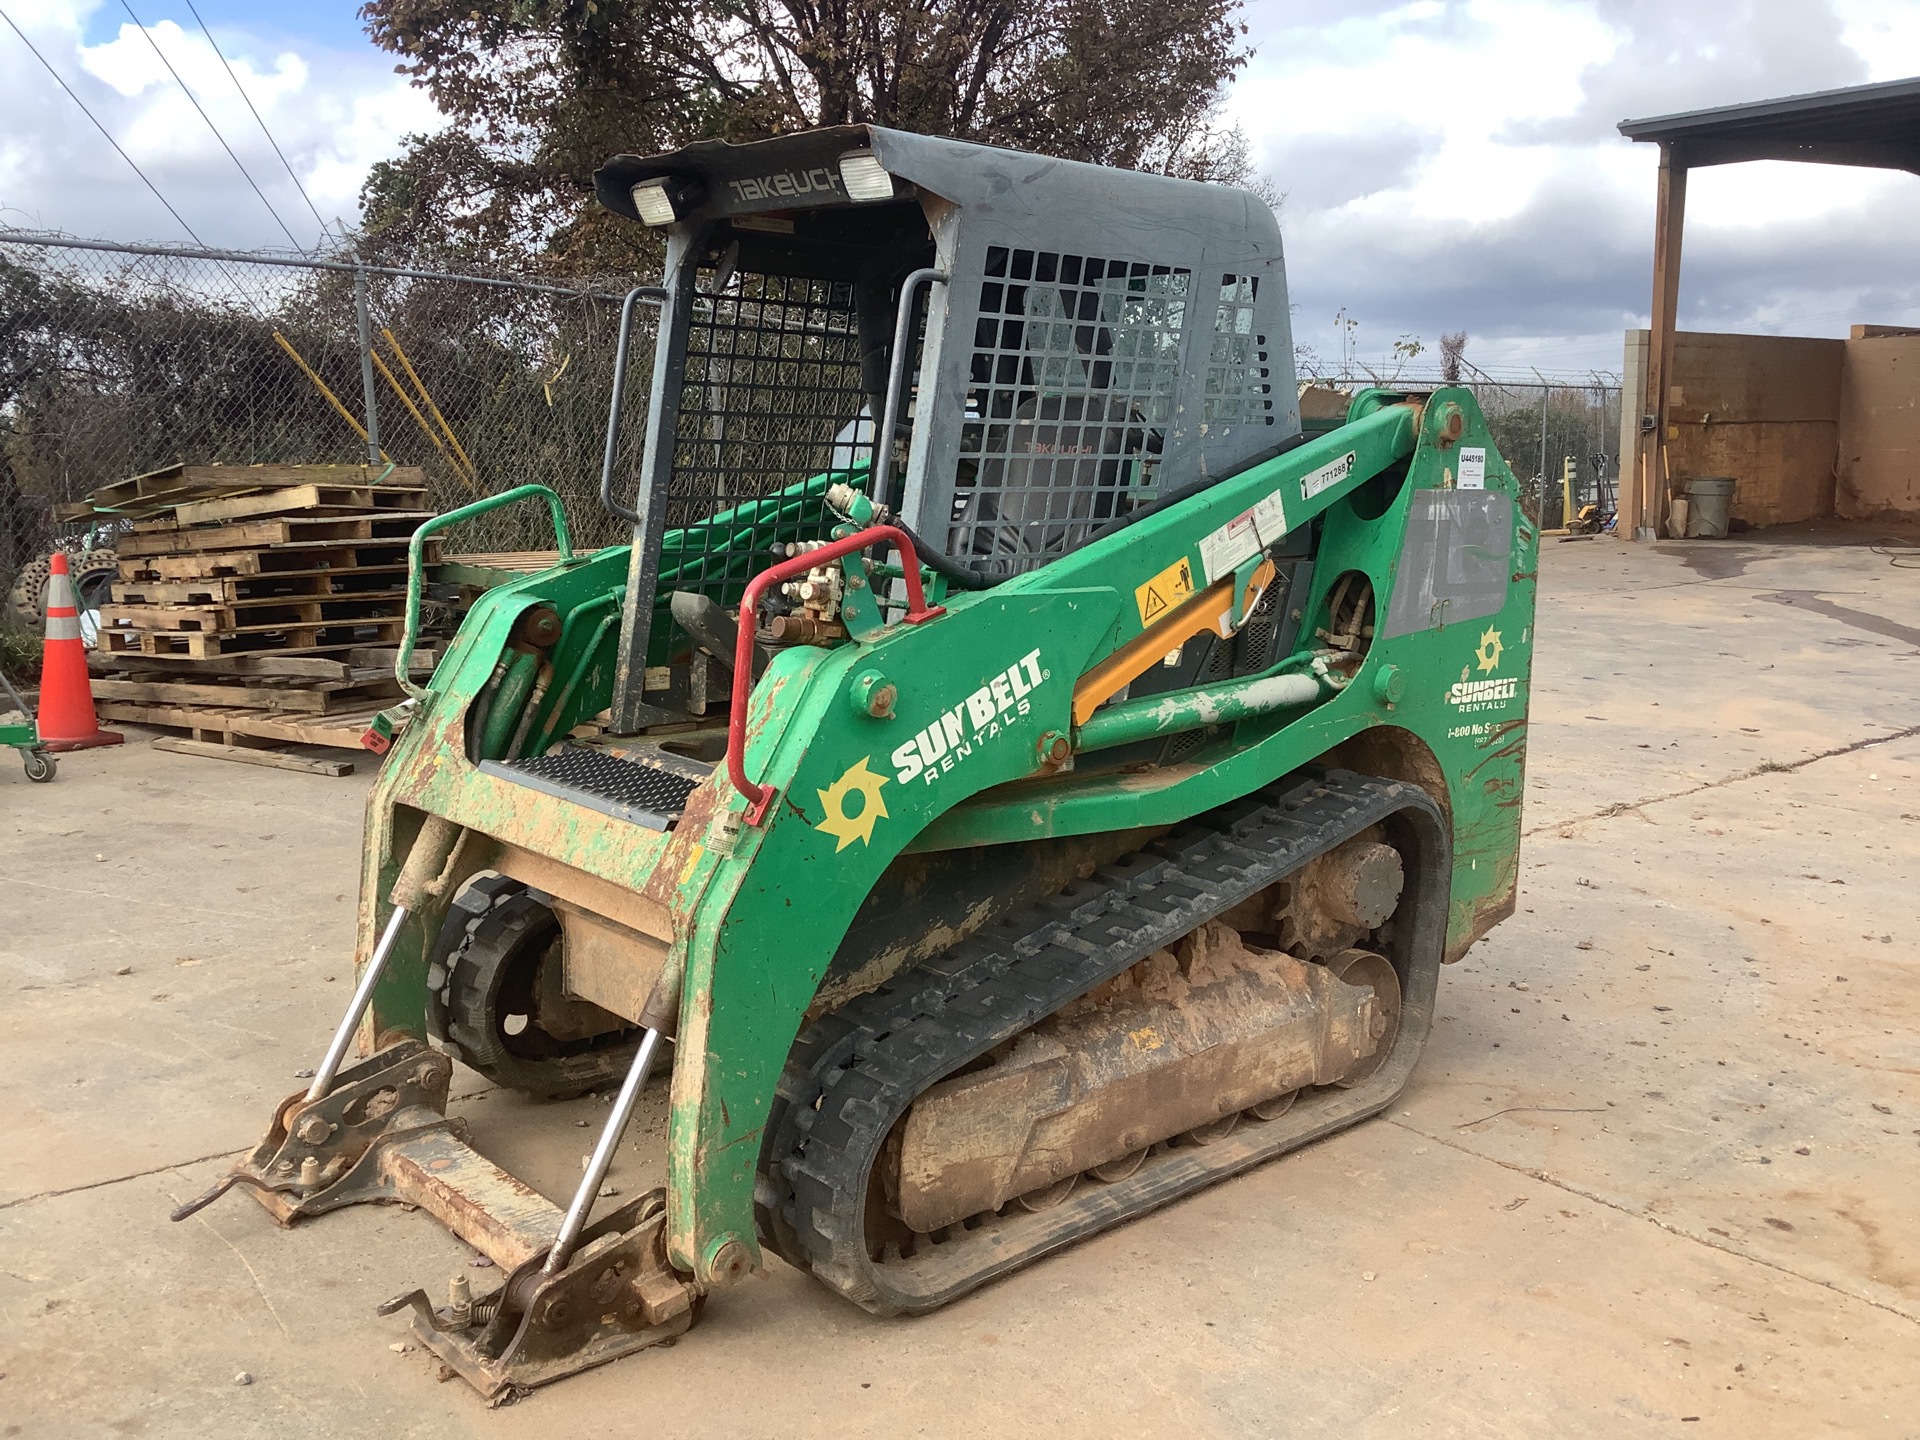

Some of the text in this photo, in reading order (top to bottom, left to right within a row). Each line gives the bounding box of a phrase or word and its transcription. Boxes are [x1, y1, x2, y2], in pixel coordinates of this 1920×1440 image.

[1321, 463, 1346, 484] 771288
[1450, 677, 1518, 705] SUNBELT
[891, 647, 1043, 785] SUNBELT
[1458, 700, 1507, 713] RENTALS
[923, 698, 1031, 786] RENTALS
[1447, 725, 1470, 739] 1-800
[1471, 723, 1483, 735] No
